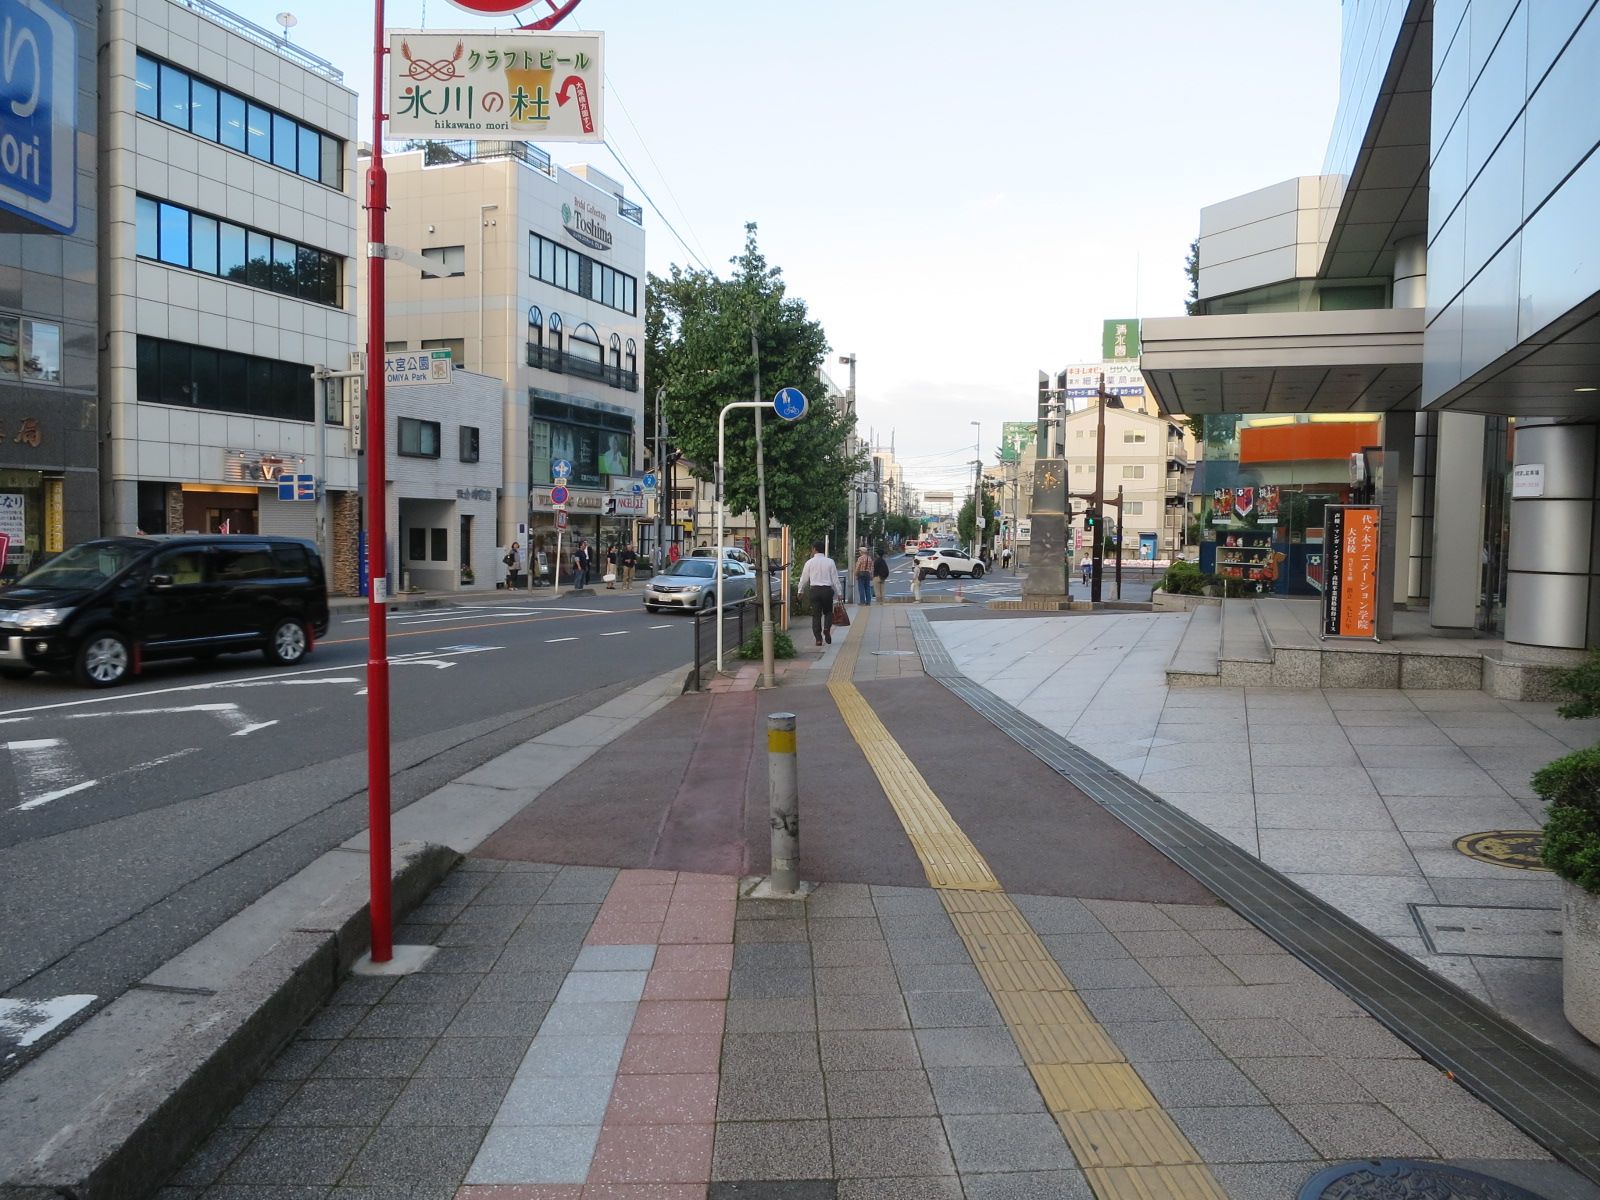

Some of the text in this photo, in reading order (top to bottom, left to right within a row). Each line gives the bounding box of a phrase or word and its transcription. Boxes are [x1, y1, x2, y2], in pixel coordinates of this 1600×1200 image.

[467, 49, 591, 71] クラフトビール
[396, 84, 551, 120] 氷川の杜
[434, 120, 509, 130] hikawano mori
[574, 211, 612, 245] Toshima
[385, 356, 429, 372] 大宮公園
[387, 372, 427, 382] OMIYA Park
[1356, 514, 1373, 630] 代々木アニメーション学院
